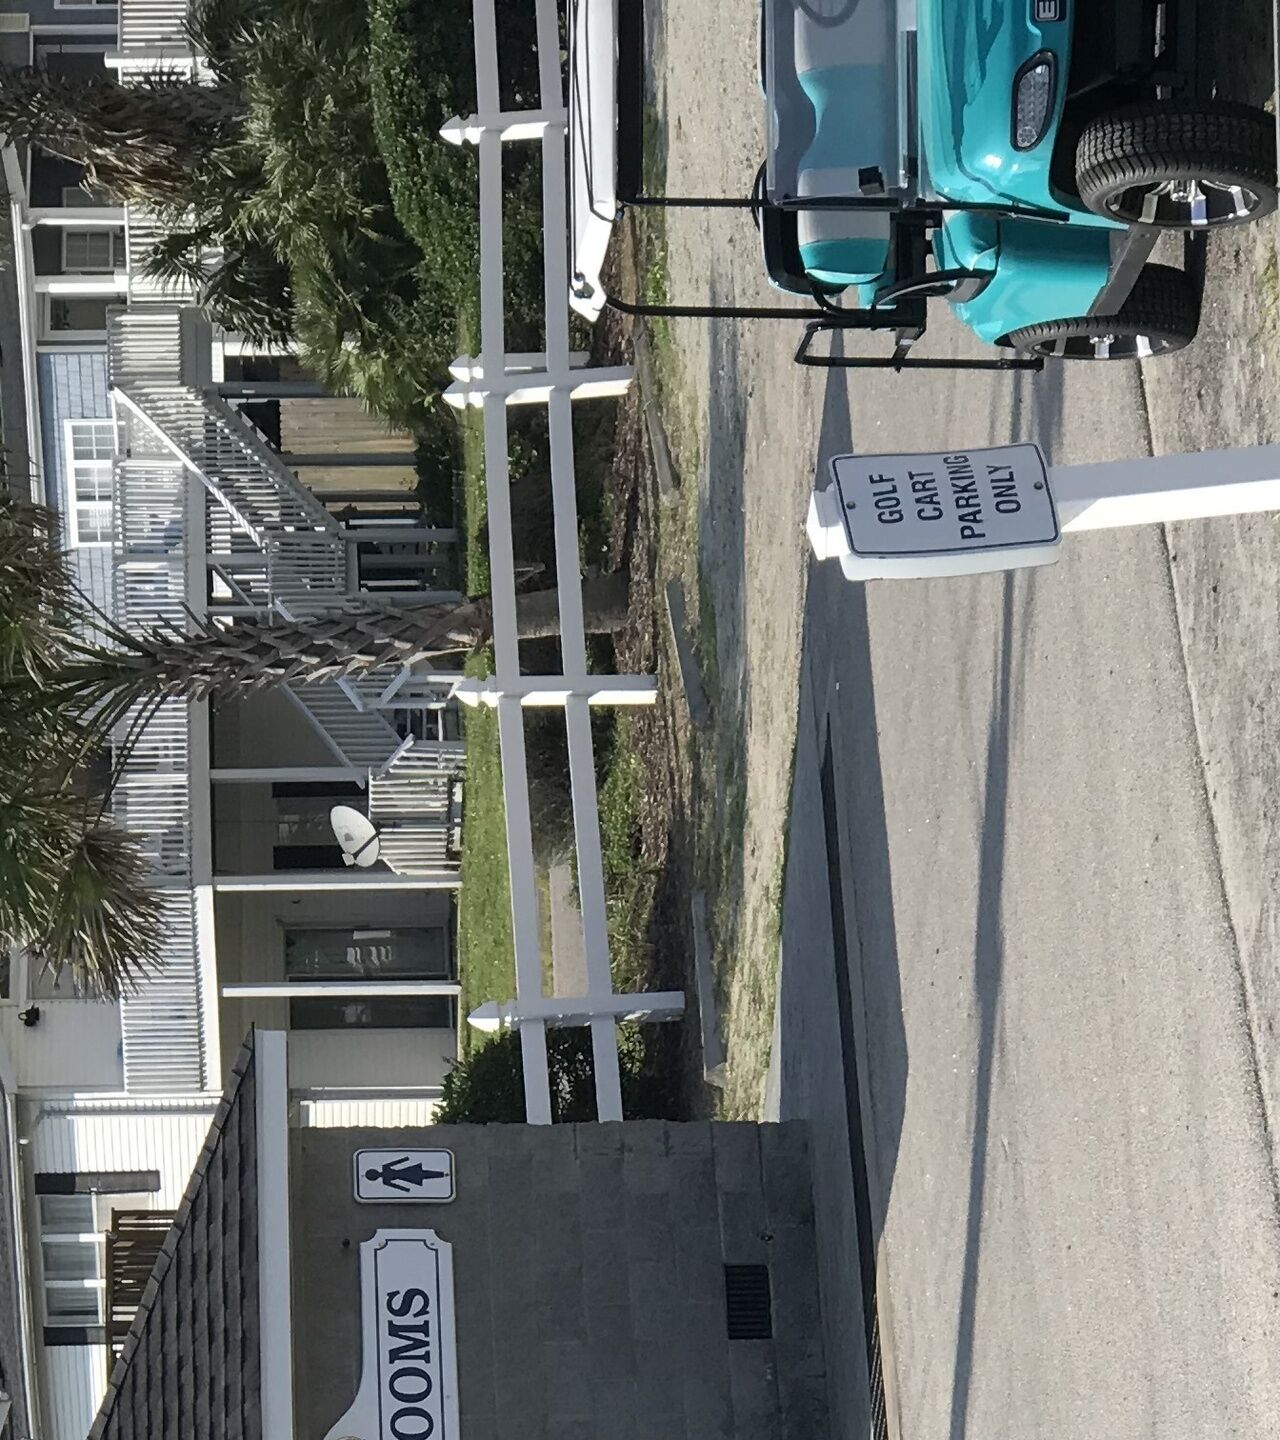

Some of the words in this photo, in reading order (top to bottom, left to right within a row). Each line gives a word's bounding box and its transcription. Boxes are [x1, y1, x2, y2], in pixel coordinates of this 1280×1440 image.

[869, 473, 904, 524] GOLF
[908, 471, 943, 521] CART
[943, 455, 986, 539] PARKING
[986, 465, 1021, 514] ONLY
